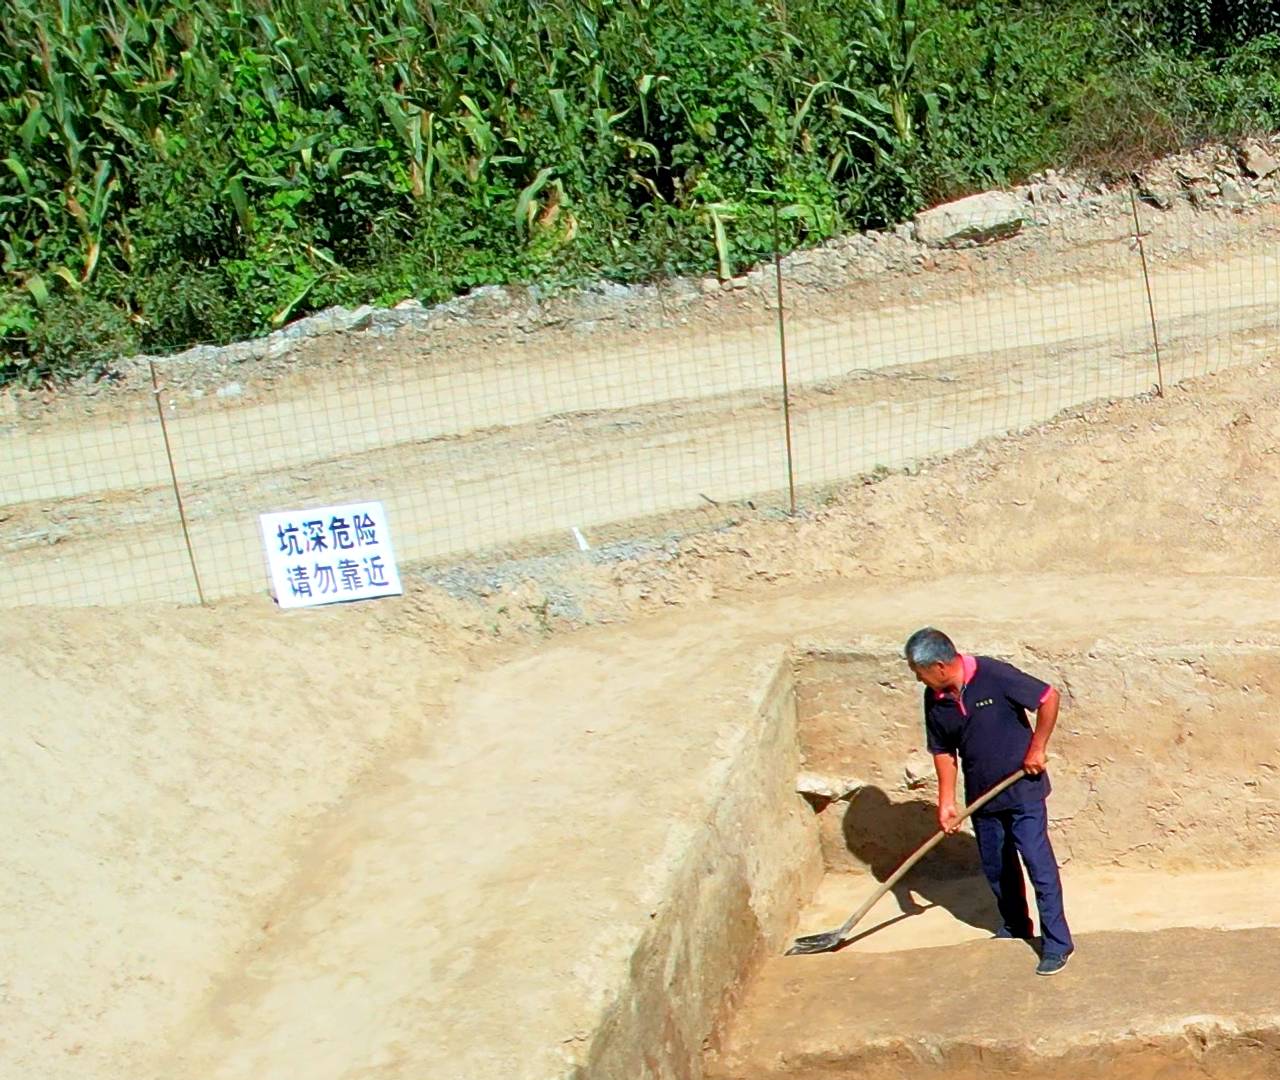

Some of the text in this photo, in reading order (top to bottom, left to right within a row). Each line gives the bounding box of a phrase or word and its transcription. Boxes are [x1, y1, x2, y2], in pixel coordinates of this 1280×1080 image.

[277, 512, 379, 556] 坑深危险
[286, 555, 389, 598] 请勿靠近
